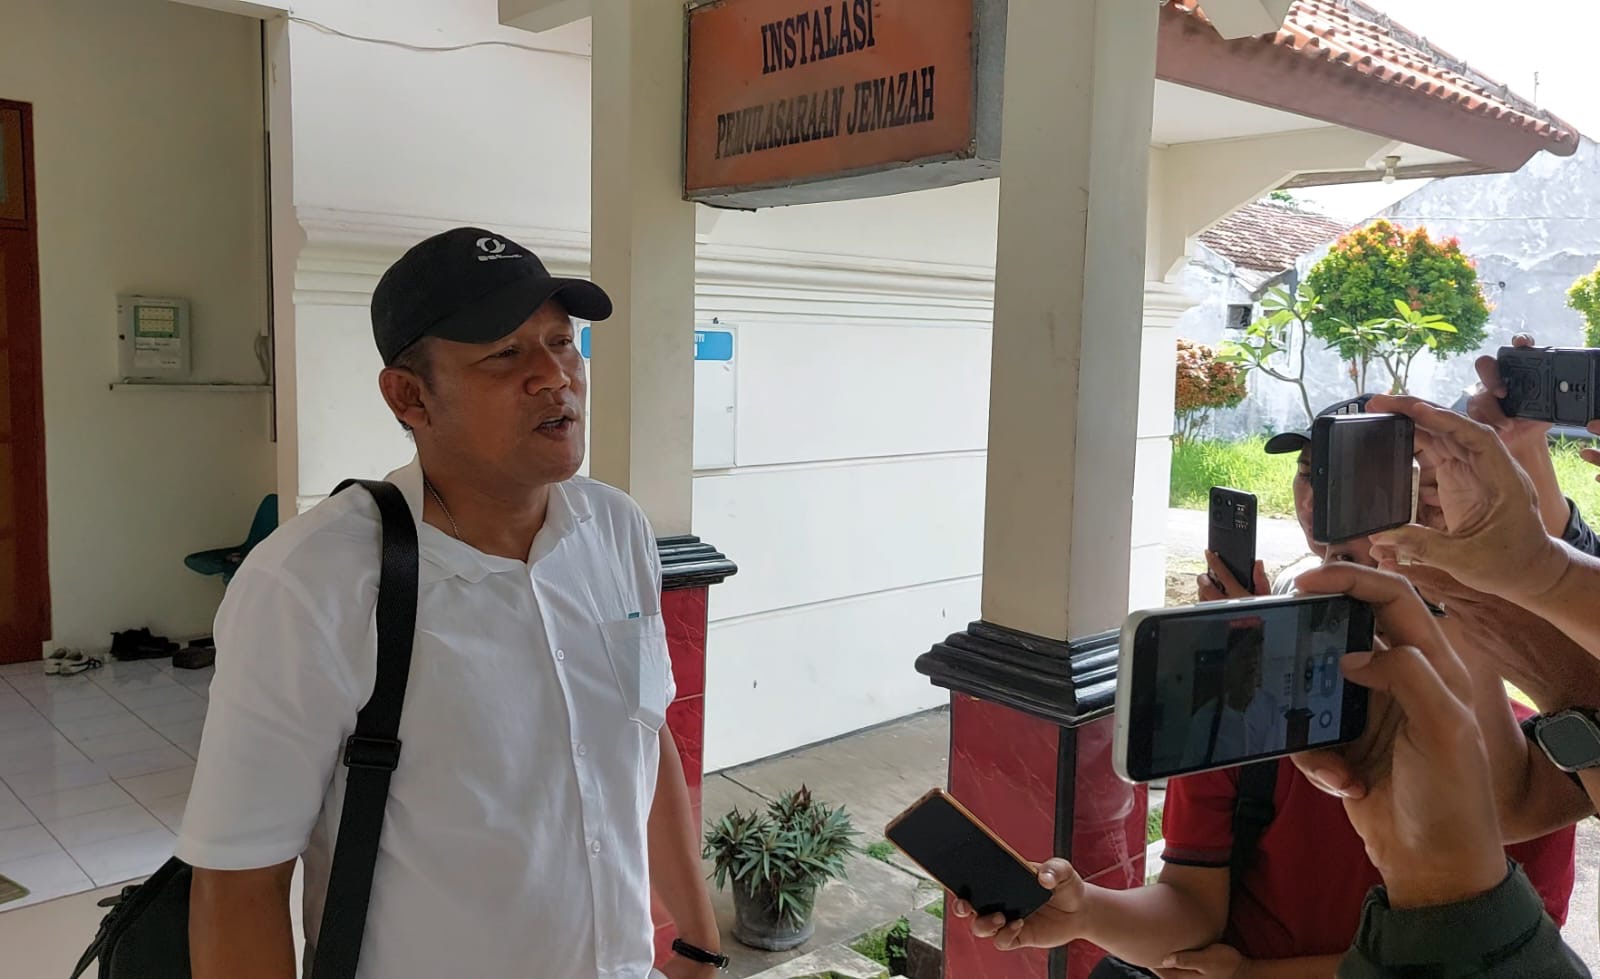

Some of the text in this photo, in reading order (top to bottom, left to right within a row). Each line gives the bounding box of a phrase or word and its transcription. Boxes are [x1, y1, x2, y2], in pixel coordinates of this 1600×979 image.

[761, 0, 876, 75] INSTALASI
[714, 65, 935, 160] PEMULASARAAN JENAZAH
